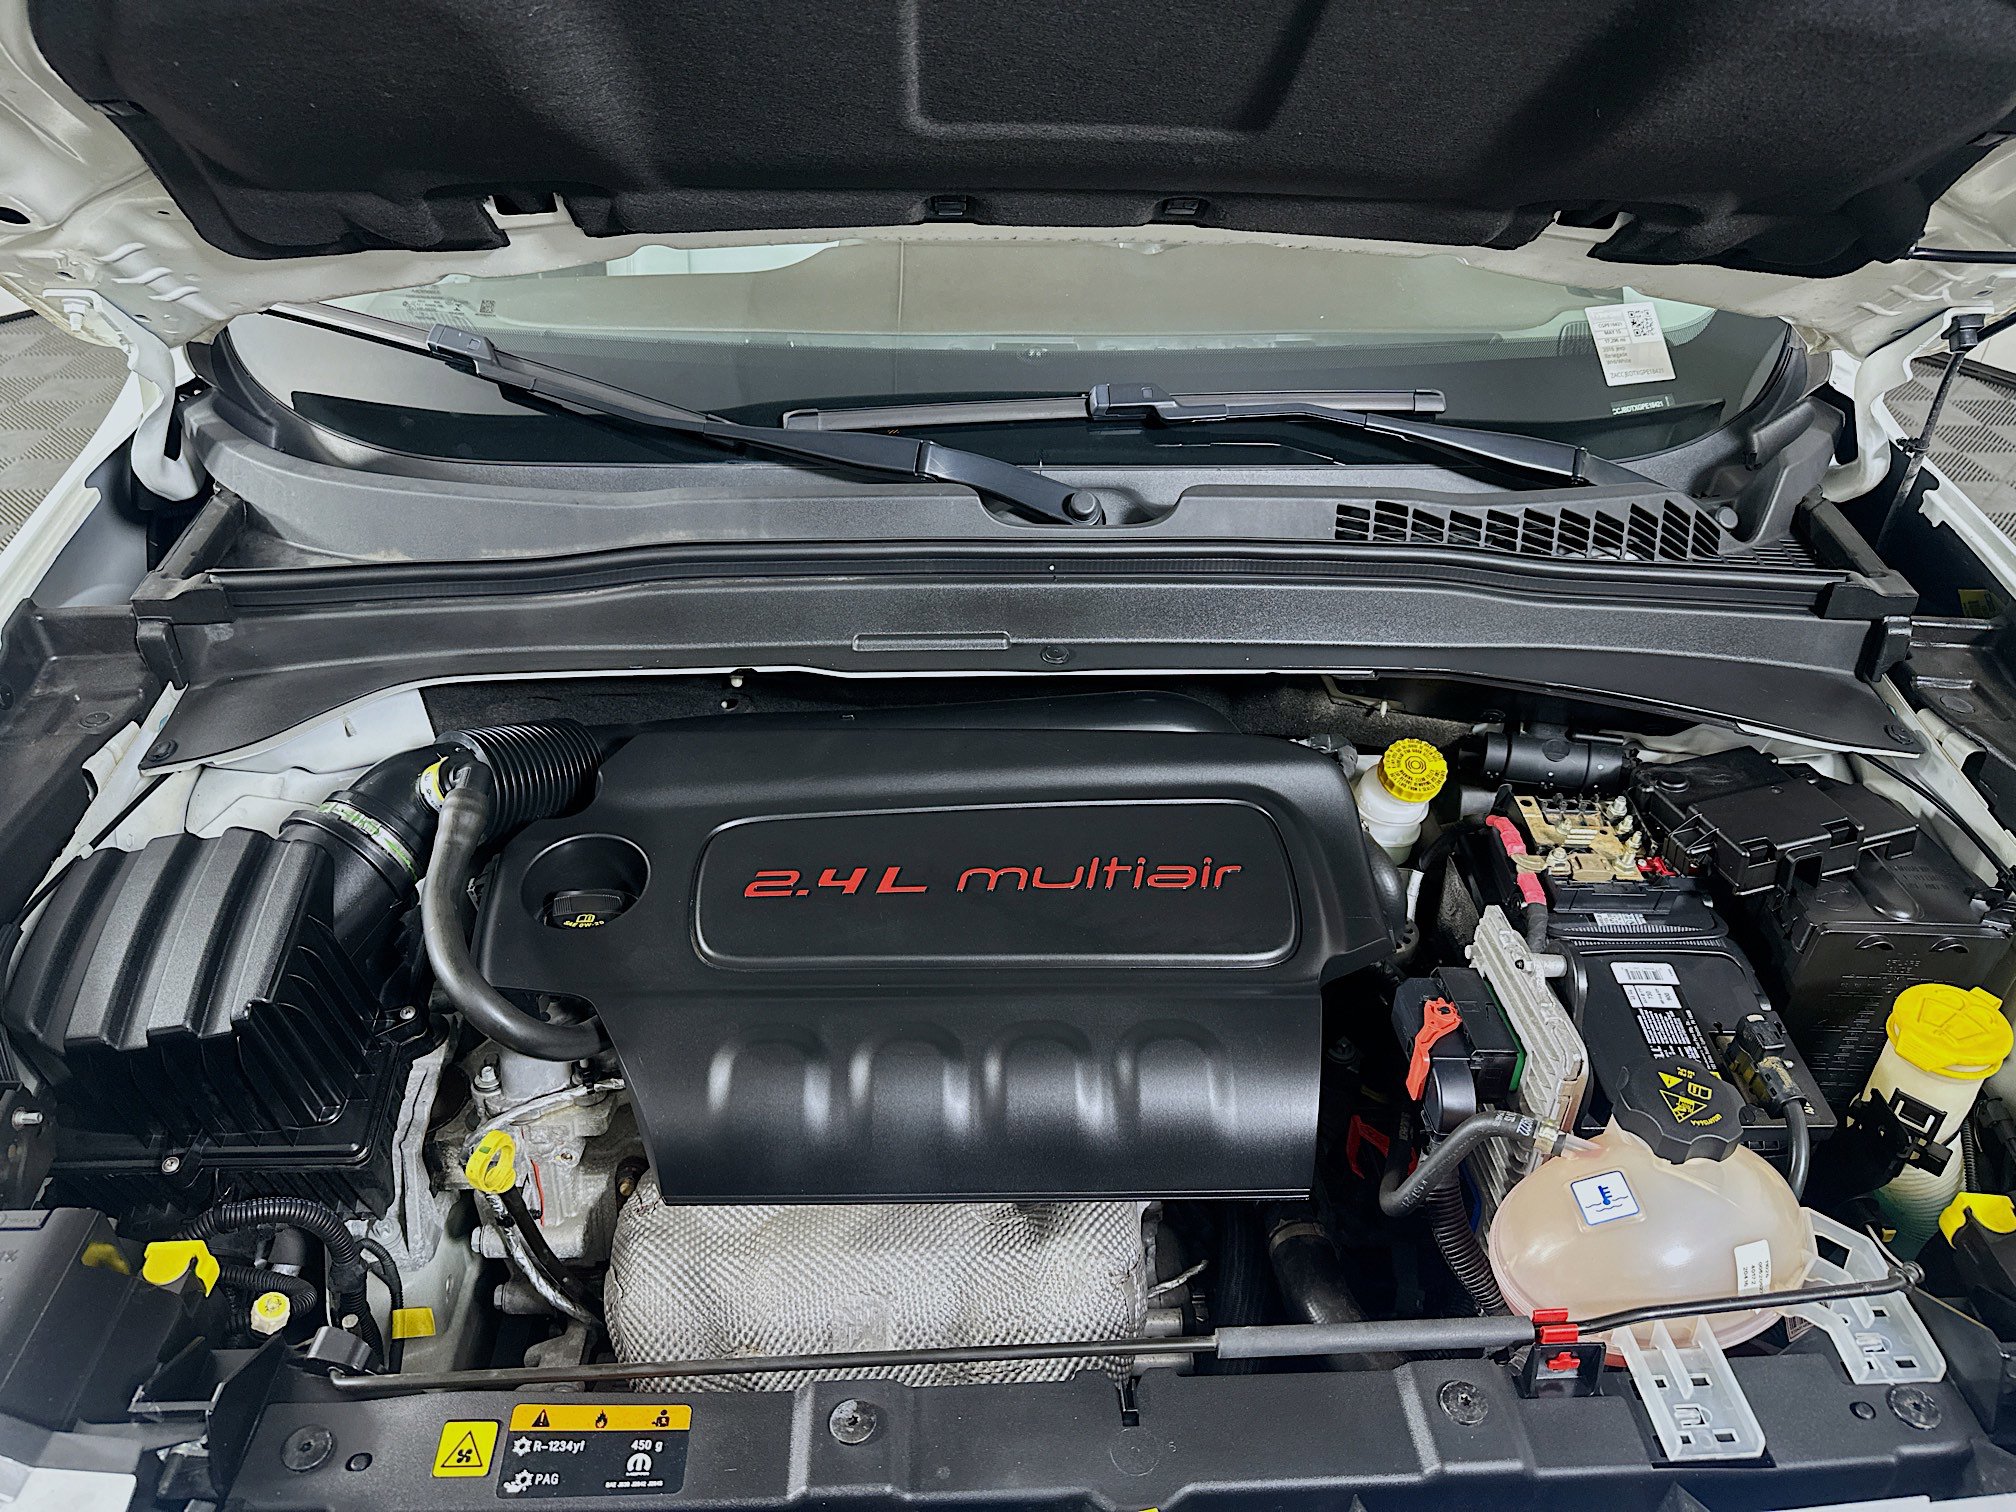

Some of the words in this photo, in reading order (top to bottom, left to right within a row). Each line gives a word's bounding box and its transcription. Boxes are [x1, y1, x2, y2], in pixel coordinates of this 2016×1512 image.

[743, 866, 928, 899] 2.4L
[956, 855, 1242, 892] multiair
[533, 1440, 586, 1454] R-1234yf
[631, 1439, 653, 1451] 450
[655, 1441, 664, 1453] g
[534, 1472, 560, 1486] PAG
